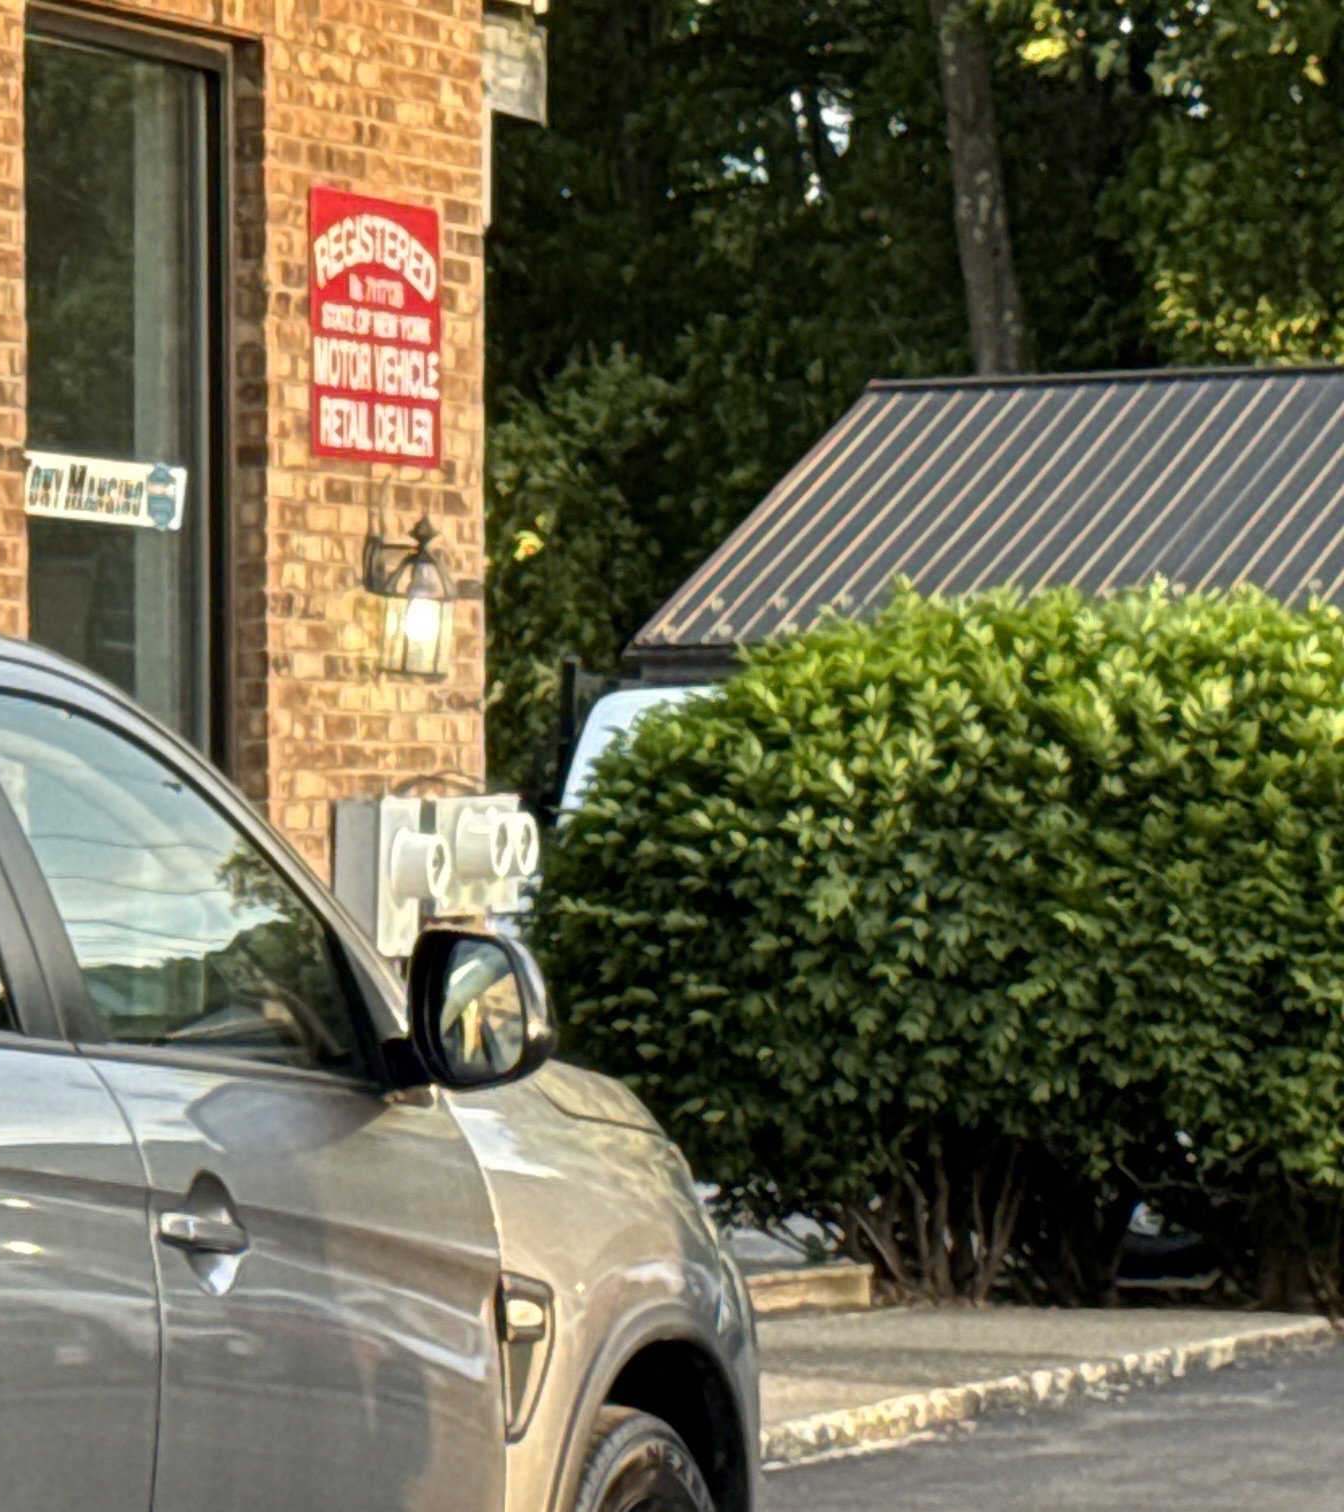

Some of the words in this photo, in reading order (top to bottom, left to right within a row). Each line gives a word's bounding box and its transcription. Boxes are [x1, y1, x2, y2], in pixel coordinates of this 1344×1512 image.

[313, 214, 437, 303] REGISTERED
[313, 335, 373, 392] MOTOR
[374, 343, 439, 401] VEHICLE
[319, 395, 372, 452] RETAIL
[374, 402, 434, 458] DEALER
